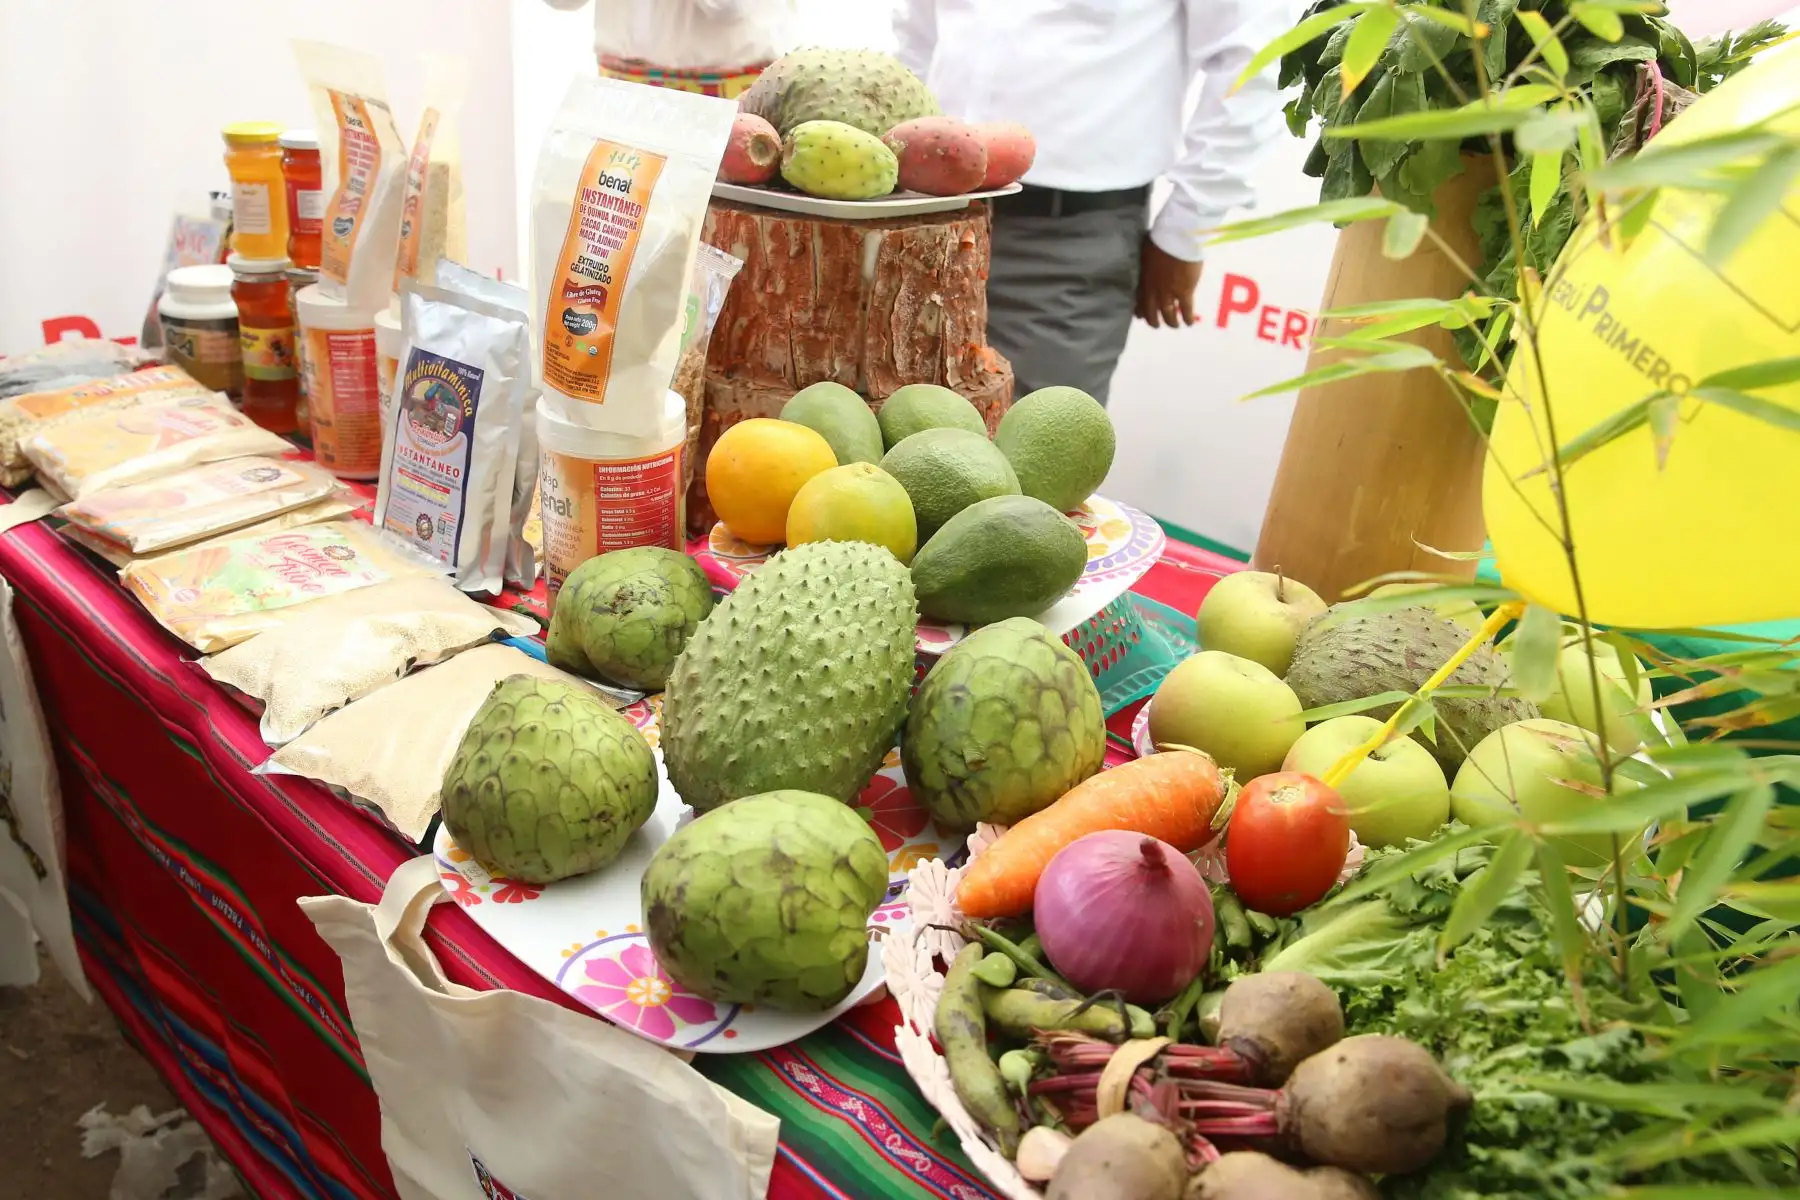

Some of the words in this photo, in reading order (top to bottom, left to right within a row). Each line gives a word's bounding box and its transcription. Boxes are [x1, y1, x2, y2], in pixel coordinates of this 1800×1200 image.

[598, 170, 632, 194] benat
[579, 204, 587, 214] DE
[581, 187, 642, 219] INSTANTÁNEO
[586, 243, 591, 252] Y
[570, 263, 612, 285] GELATINIZADO
[577, 256, 609, 273] EXTRUIDO
[585, 288, 601, 297] Gluten
[1216, 272, 1318, 350] PER
[581, 318, 597, 332] 200g
[1550, 278, 1588, 312] ERÚ
[1577, 284, 1692, 398] PRIMERO
[598, 465, 641, 474] INFORMACIÓN
[541, 491, 573, 518] enat
